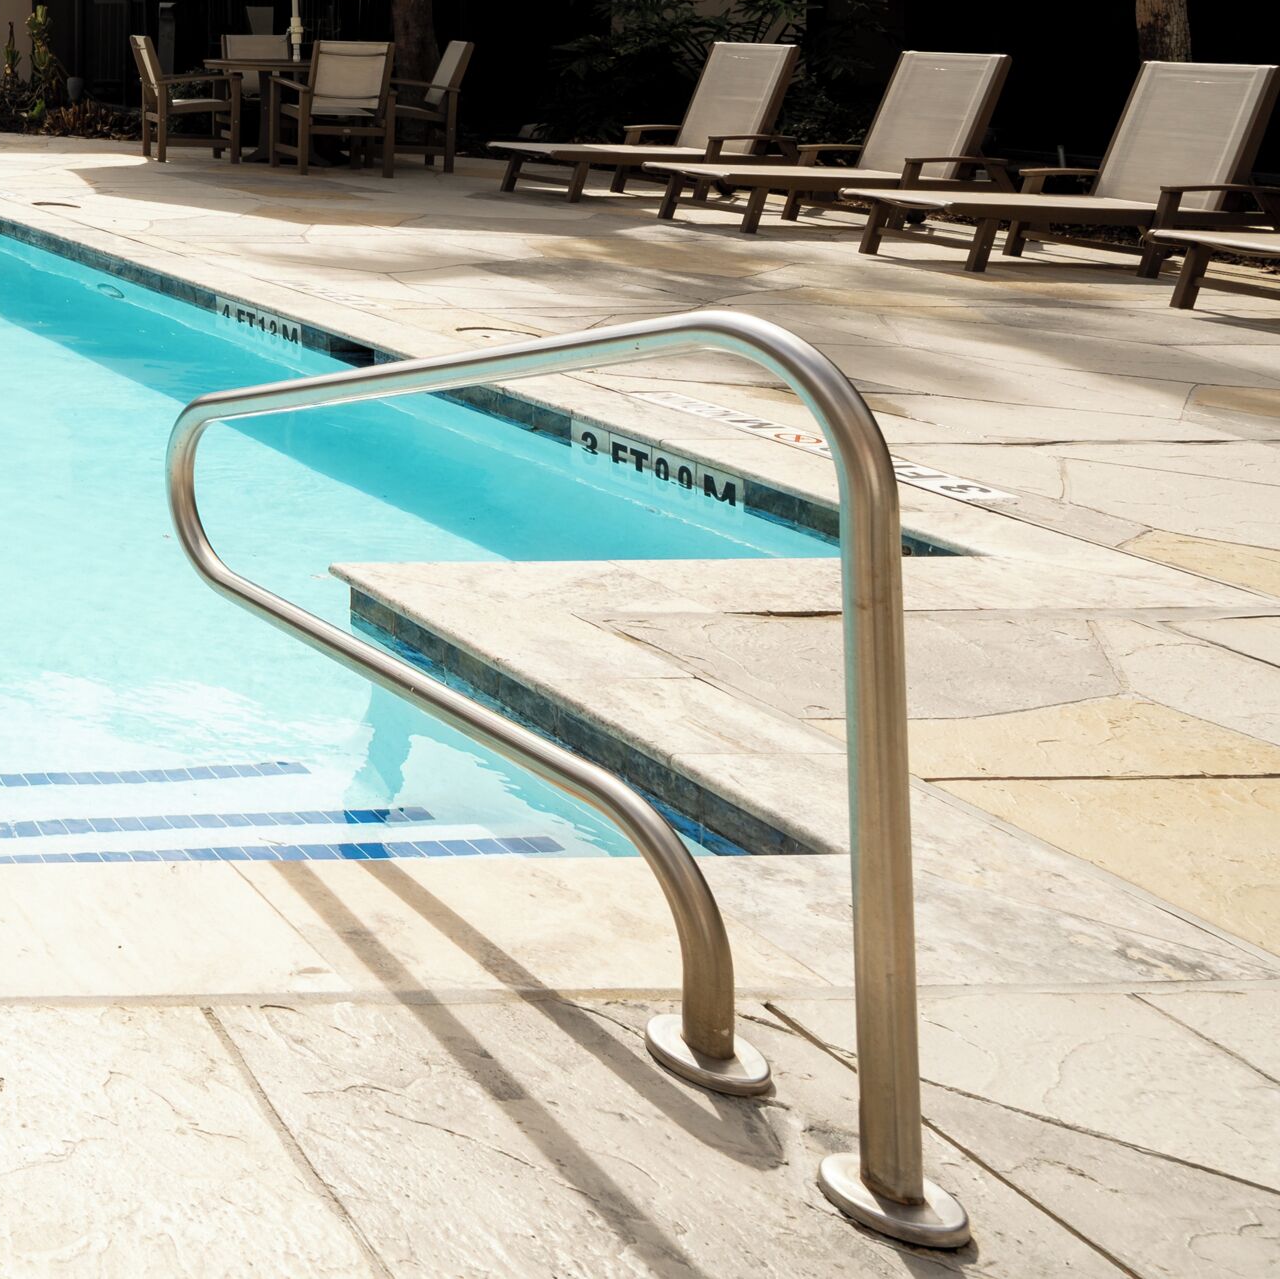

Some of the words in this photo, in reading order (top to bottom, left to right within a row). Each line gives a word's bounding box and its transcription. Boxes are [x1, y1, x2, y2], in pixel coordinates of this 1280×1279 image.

[282, 324, 298, 344] M
[611, 441, 648, 472] FT
[703, 473, 737, 507] M
